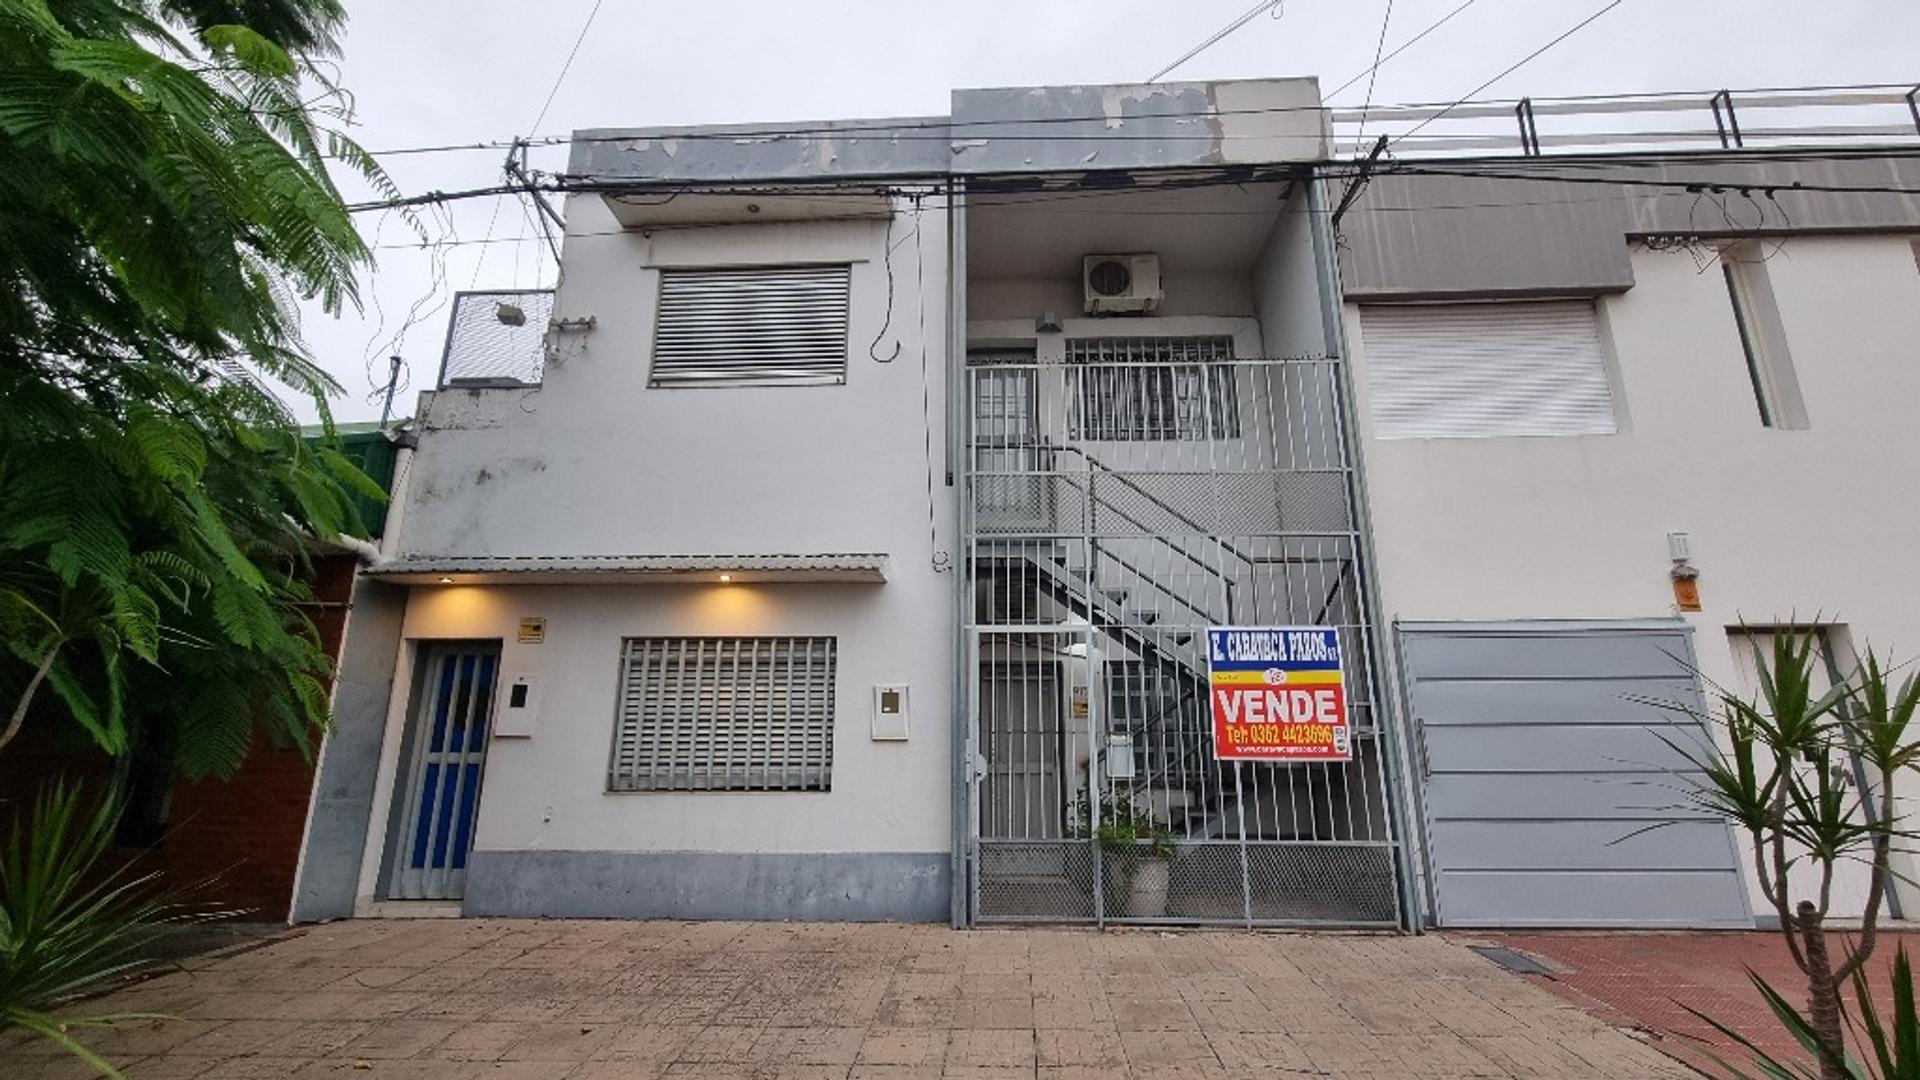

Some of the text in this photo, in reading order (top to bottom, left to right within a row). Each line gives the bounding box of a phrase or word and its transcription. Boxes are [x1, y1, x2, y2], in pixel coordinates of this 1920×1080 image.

[1211, 632, 1225, 661] E.
[1288, 632, 1327, 661] PAZOS
[1217, 690, 1338, 723] VENDE
[1250, 725, 1280, 743] 0362
[1282, 724, 1333, 743] 4423696
